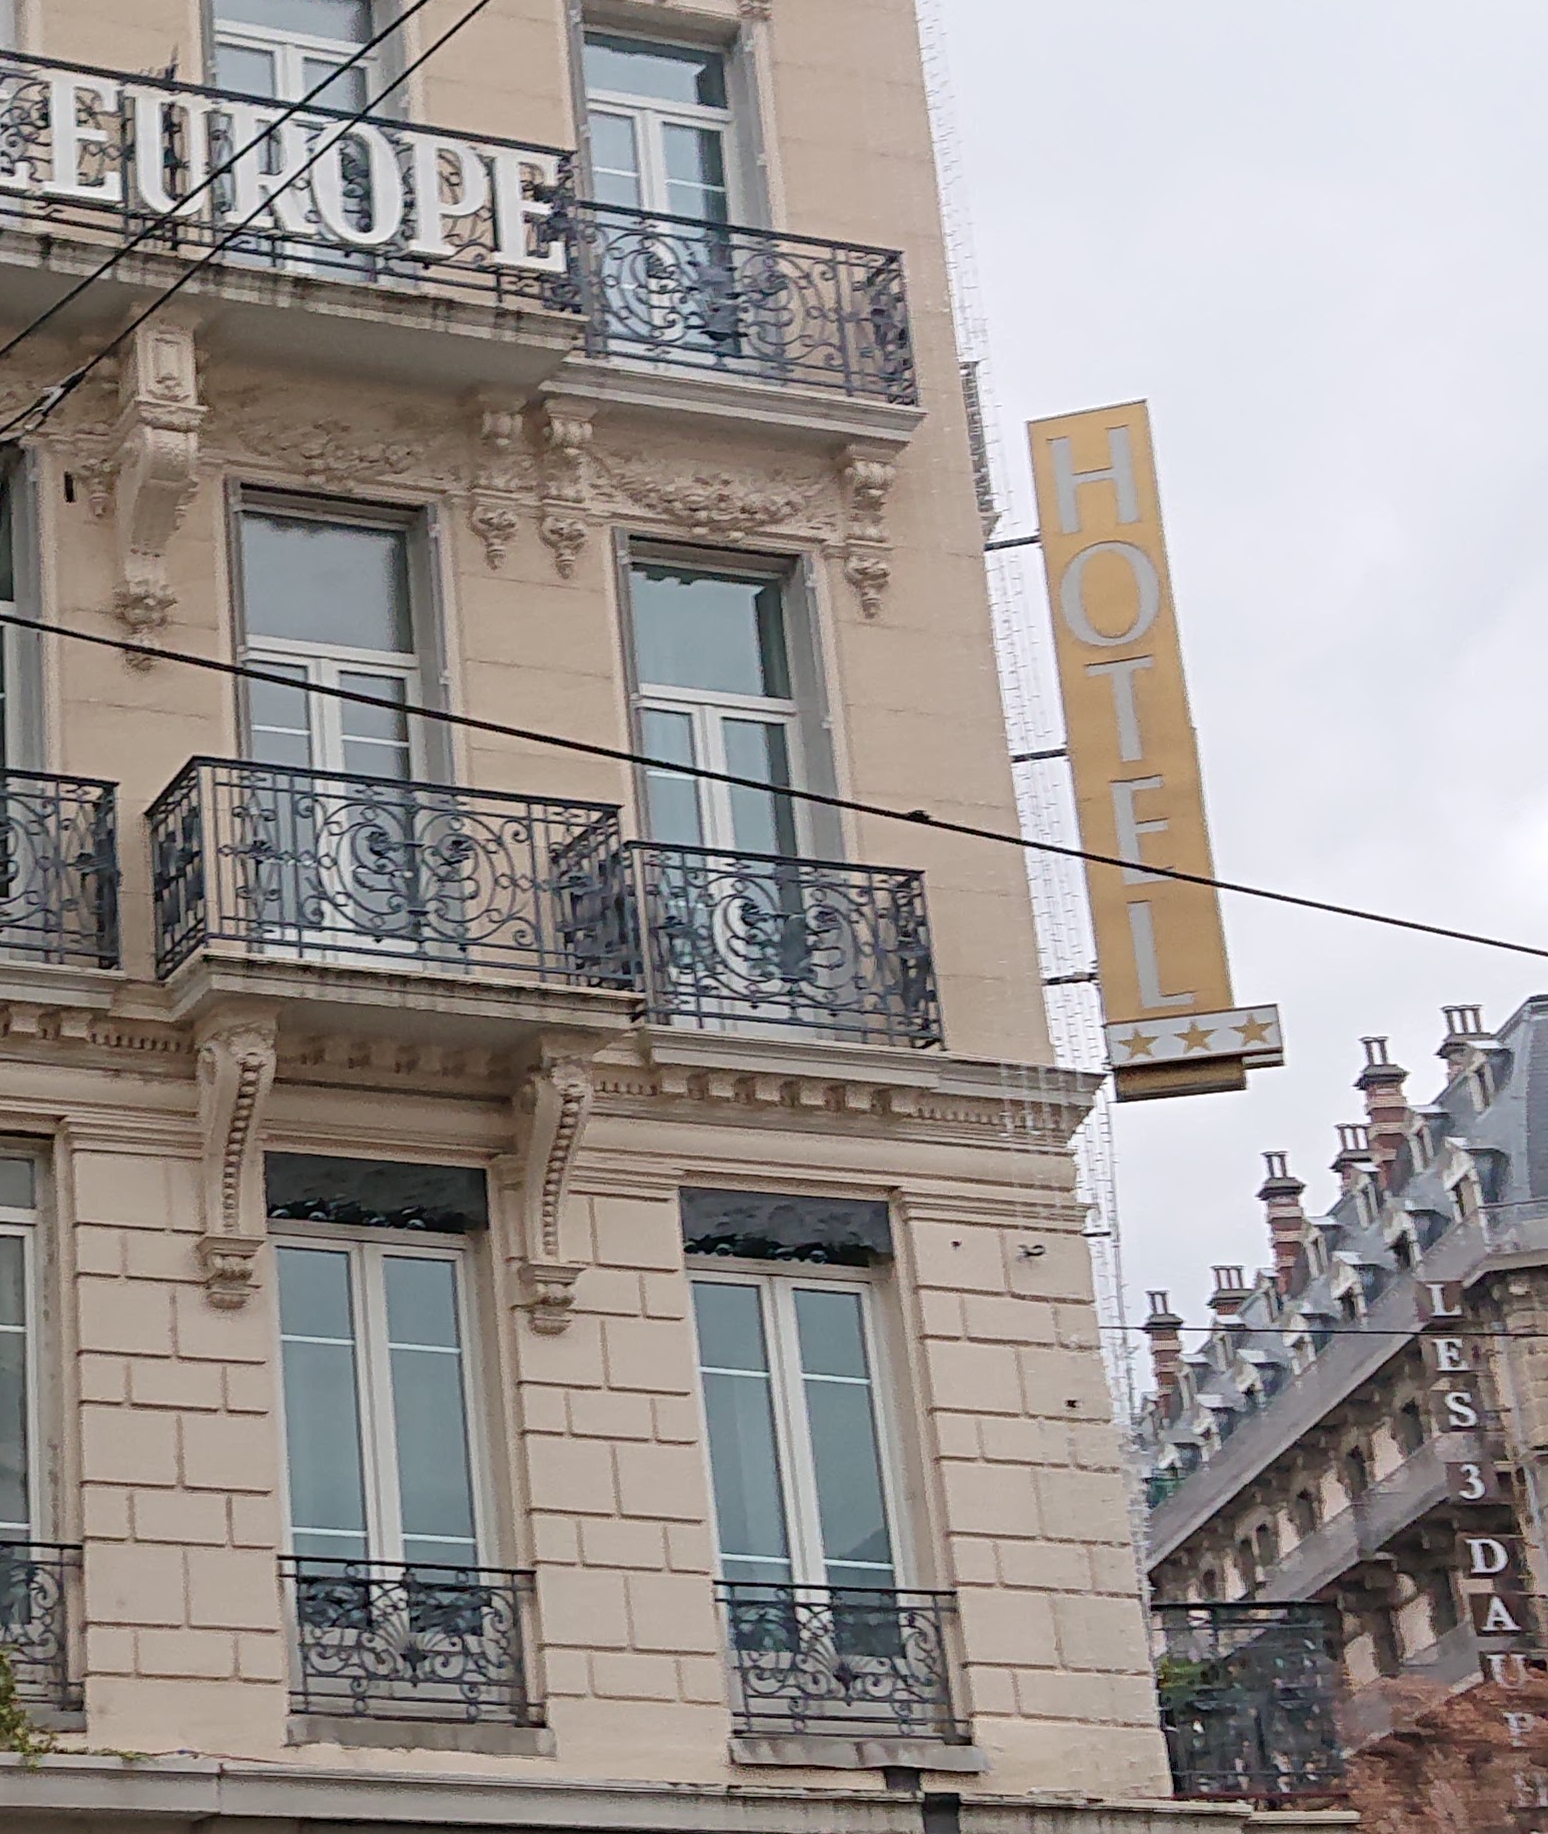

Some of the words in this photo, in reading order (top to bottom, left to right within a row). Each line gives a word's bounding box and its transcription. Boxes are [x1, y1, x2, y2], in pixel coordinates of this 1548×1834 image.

[1046, 423, 1194, 1009] HOTEL
[1428, 1282, 1479, 1429] LES
[1456, 1463, 1487, 1501] 3
